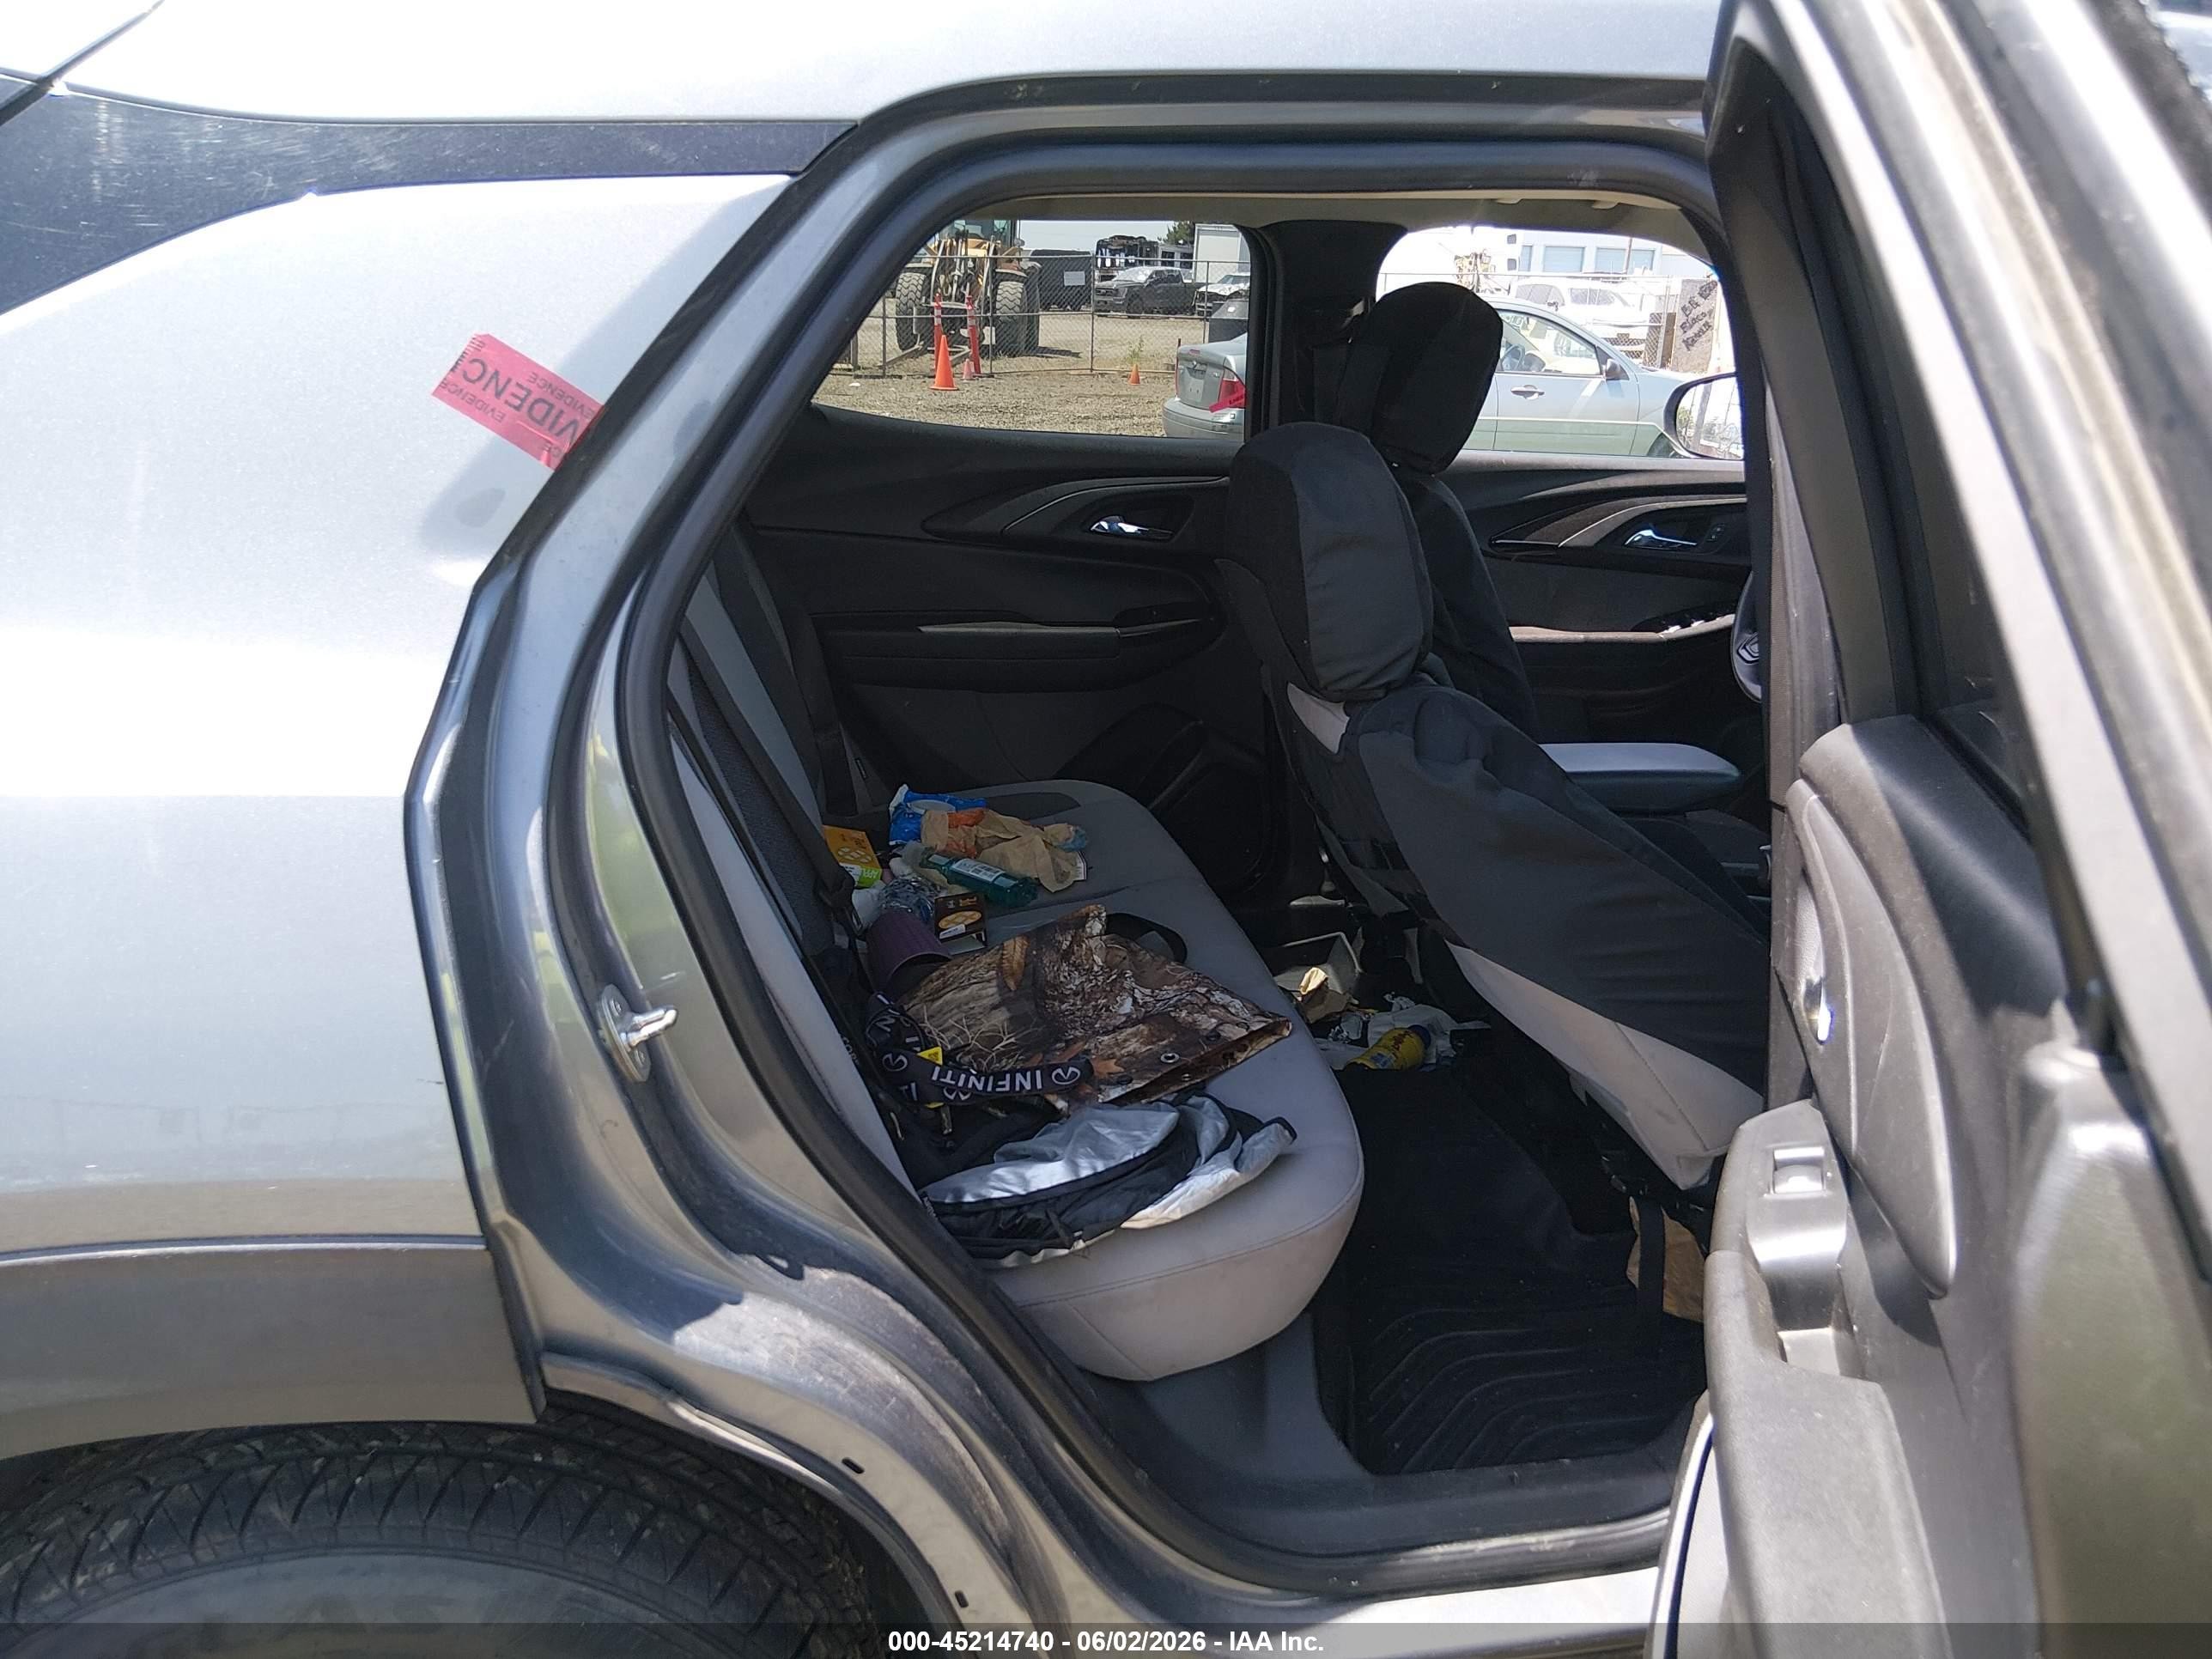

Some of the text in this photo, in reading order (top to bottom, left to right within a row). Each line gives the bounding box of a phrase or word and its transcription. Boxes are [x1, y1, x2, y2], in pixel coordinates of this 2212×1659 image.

[450, 351, 580, 447] VIDENC
[526, 372, 595, 420] EVIDENCE
[931, 1066, 1042, 1092] INFINITI
